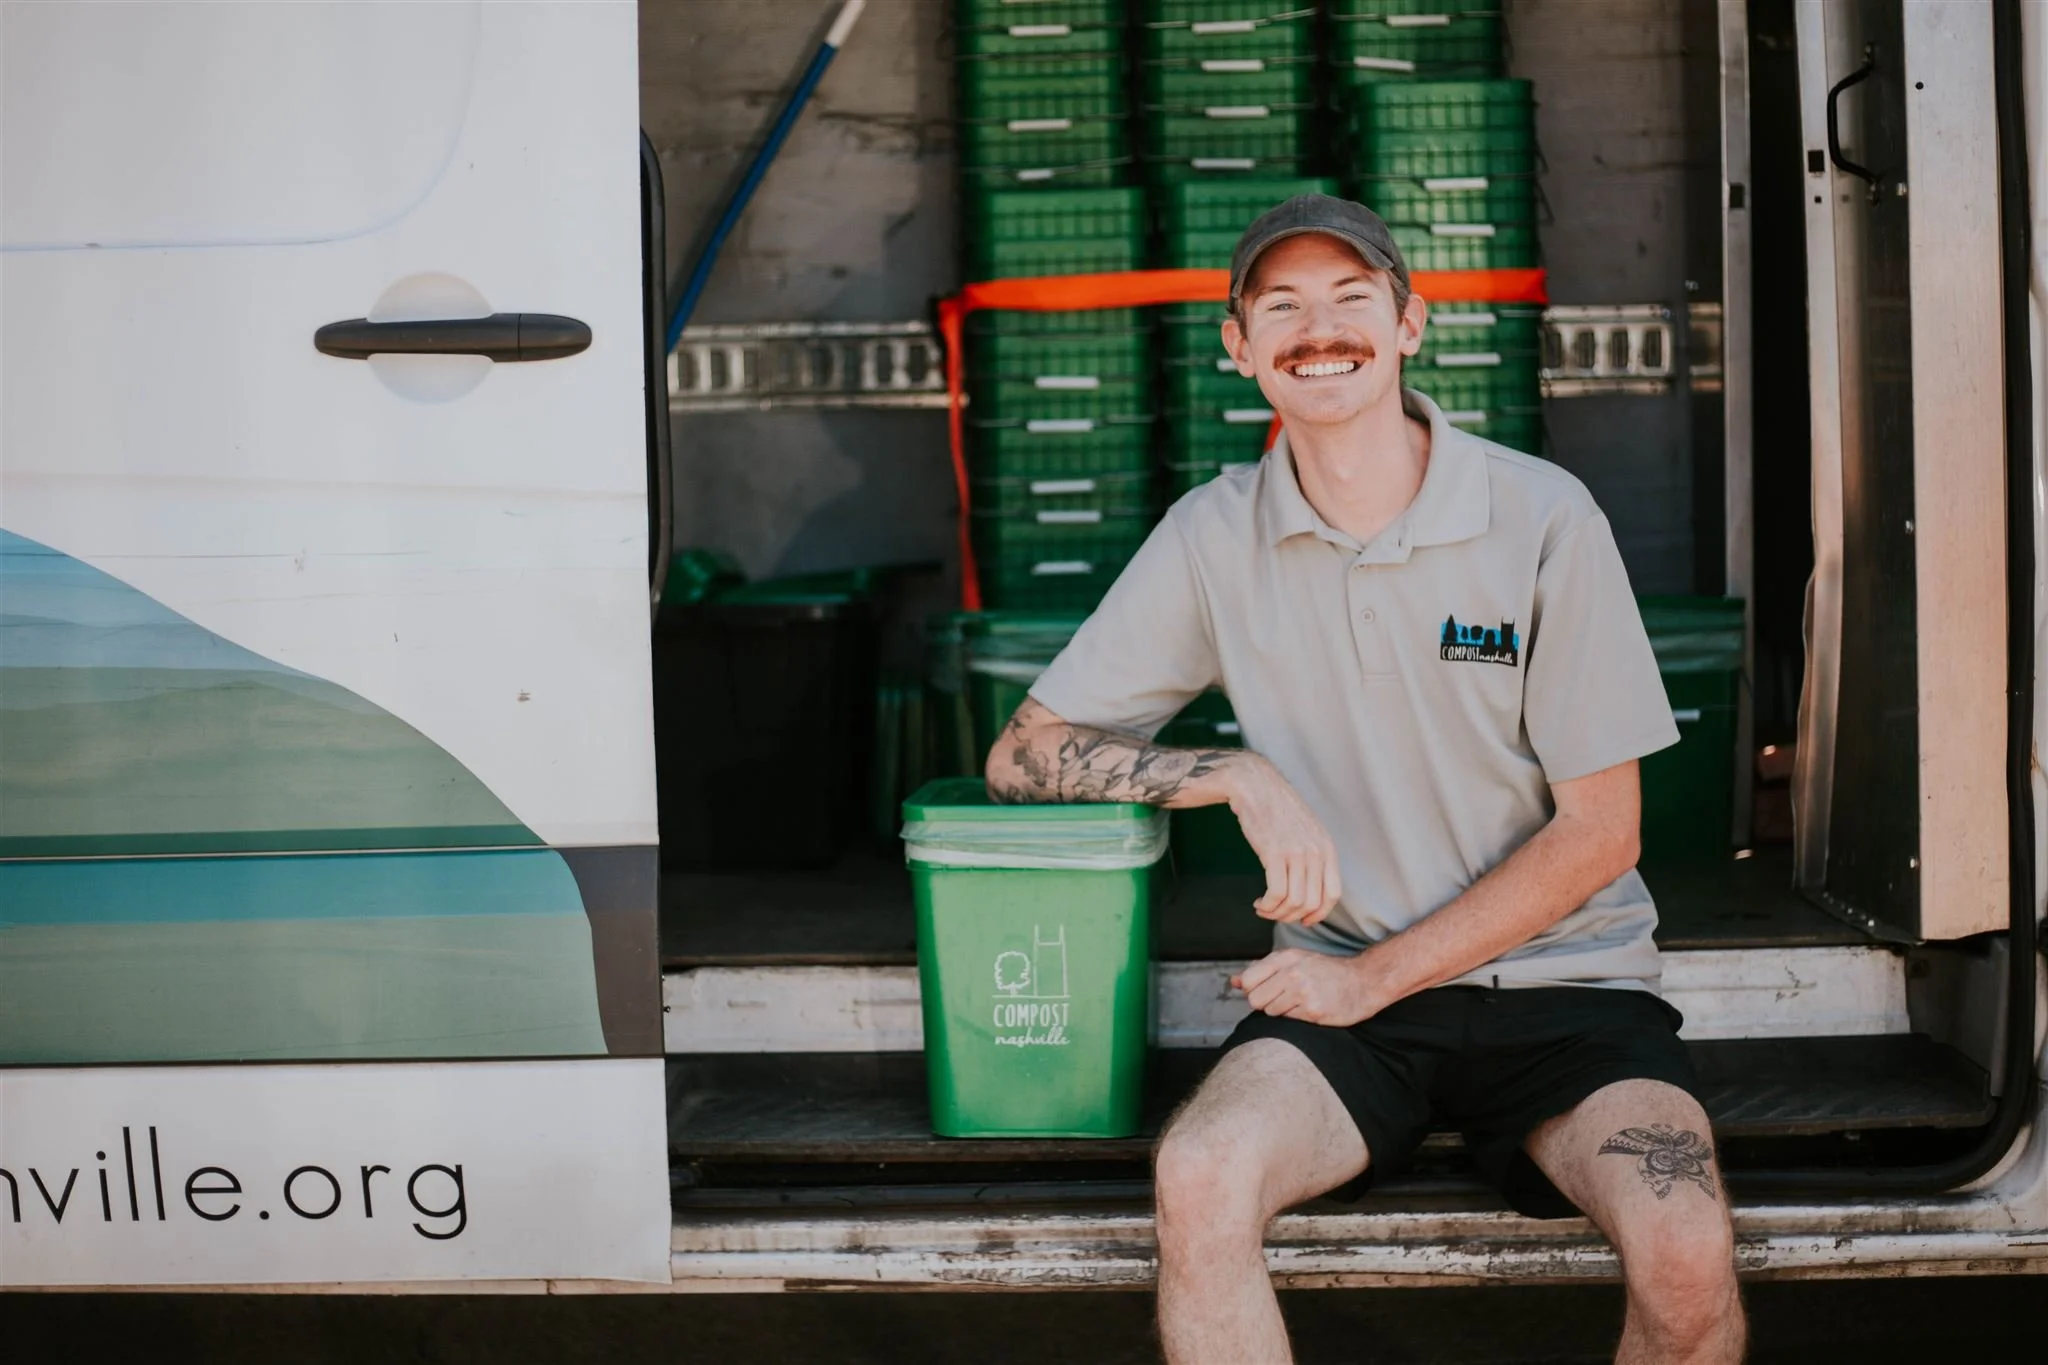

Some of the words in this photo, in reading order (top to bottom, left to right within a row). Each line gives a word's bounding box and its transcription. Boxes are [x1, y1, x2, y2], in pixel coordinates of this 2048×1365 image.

[1442, 646, 1480, 661] COMPOST
[993, 1003, 1070, 1027] COMPOST
[995, 1026, 1070, 1048] nashville
